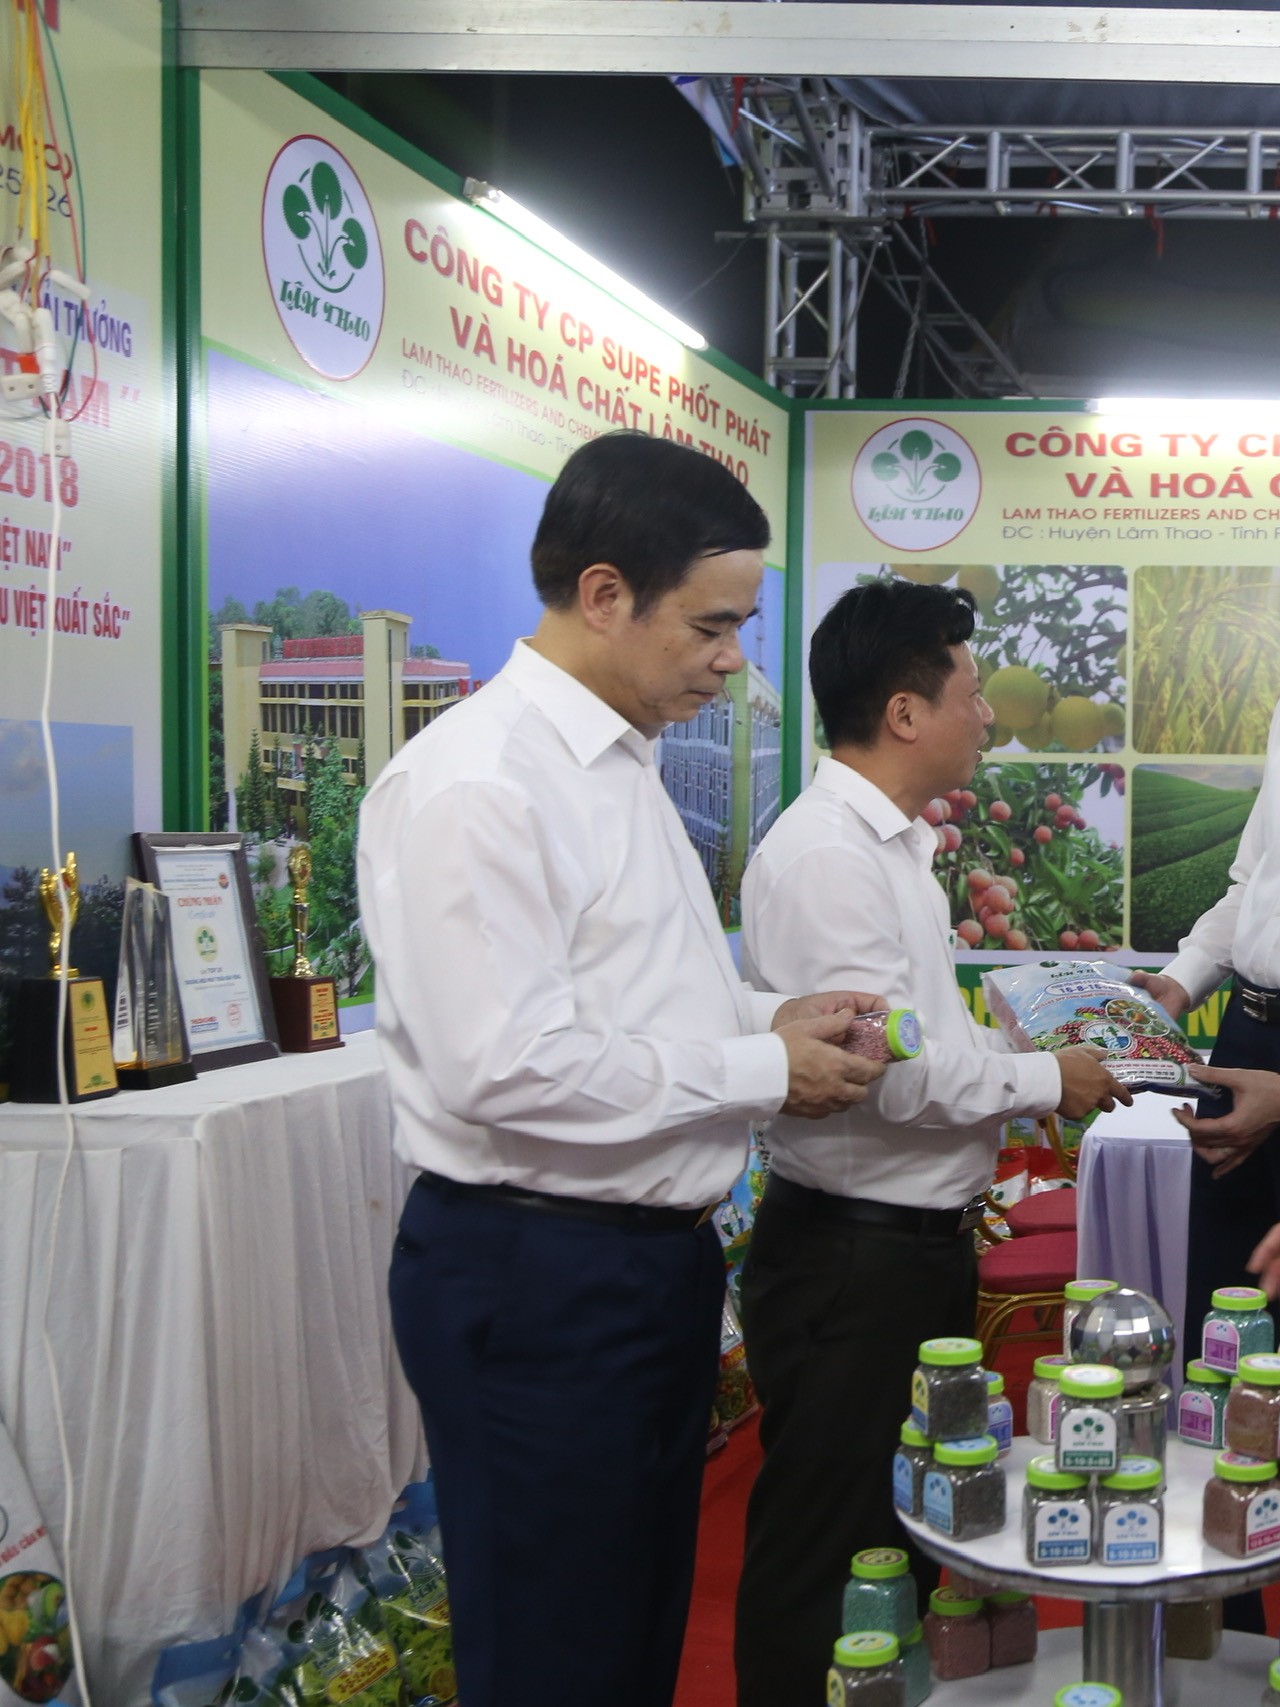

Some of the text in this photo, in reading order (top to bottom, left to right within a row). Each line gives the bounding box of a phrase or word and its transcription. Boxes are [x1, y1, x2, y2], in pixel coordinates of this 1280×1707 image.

[404, 218, 770, 456] CÔNG TY CP SUPE PHỐT PHÁT
[401, 337, 432, 369] LAM
[436, 353, 473, 386] THAO
[541, 405, 565, 429] AND
[450, 305, 497, 365] VÀ
[577, 376, 642, 430] CHẤT
[1006, 426, 1143, 458] CÔNG
[1160, 433, 1220, 458] TY
[0, 441, 78, 507] 2018
[1065, 467, 1133, 498] VÀ
[1150, 467, 1253, 498] HOÁ
[1002, 508, 1041, 521] LAM
[1046, 508, 1097, 521] THAO
[1103, 508, 1201, 521] FERTILIZERS
[1206, 508, 1247, 521] AND
[1002, 526, 1033, 539] ĐC
[1050, 526, 1111, 542] Huyện
[1117, 526, 1158, 540] Lâm
[1164, 526, 1213, 540] Thao
[14, 584, 47, 637] VIỆT
